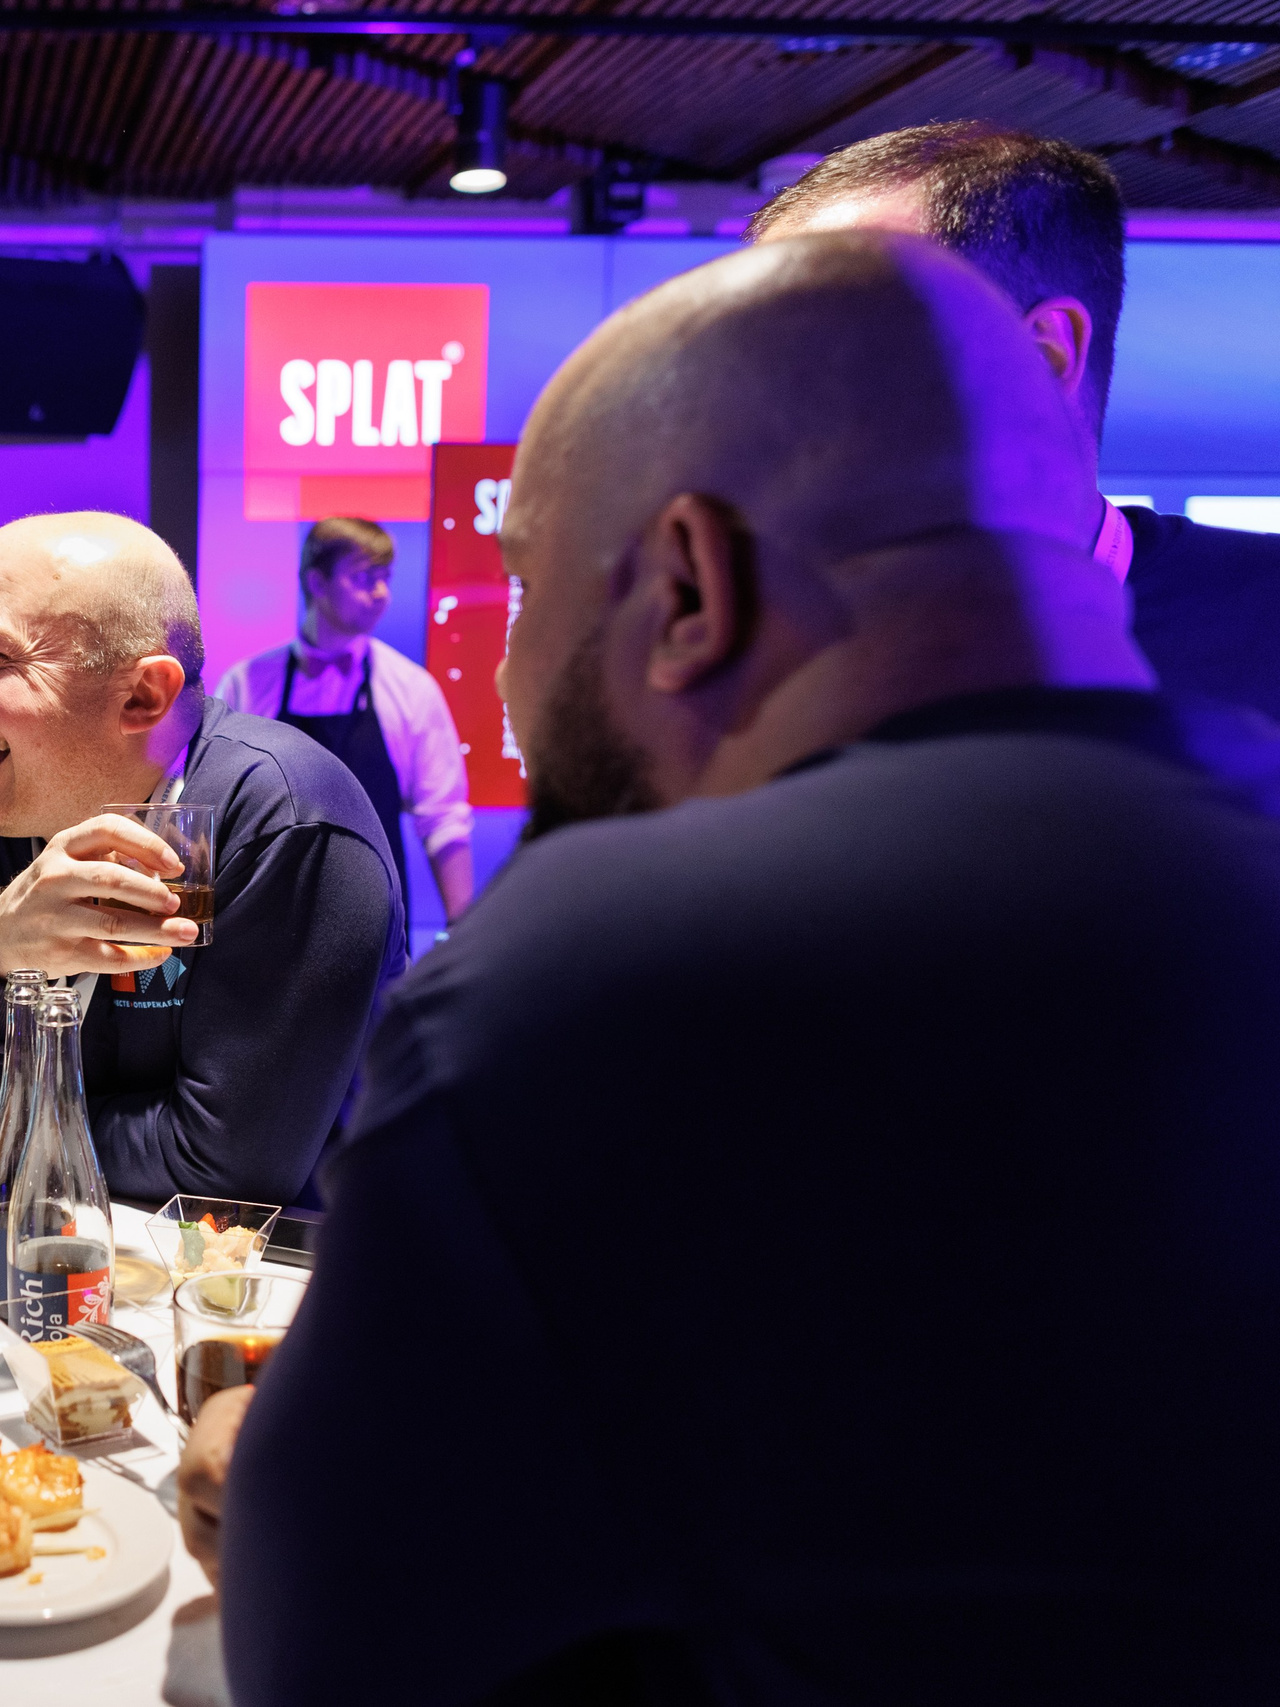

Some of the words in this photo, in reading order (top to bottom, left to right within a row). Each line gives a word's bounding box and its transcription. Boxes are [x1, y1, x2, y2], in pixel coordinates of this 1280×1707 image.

[280, 359, 452, 446] SPLAT
[20, 1279, 43, 1342] Rich
[45, 1314, 63, 1342] ola
